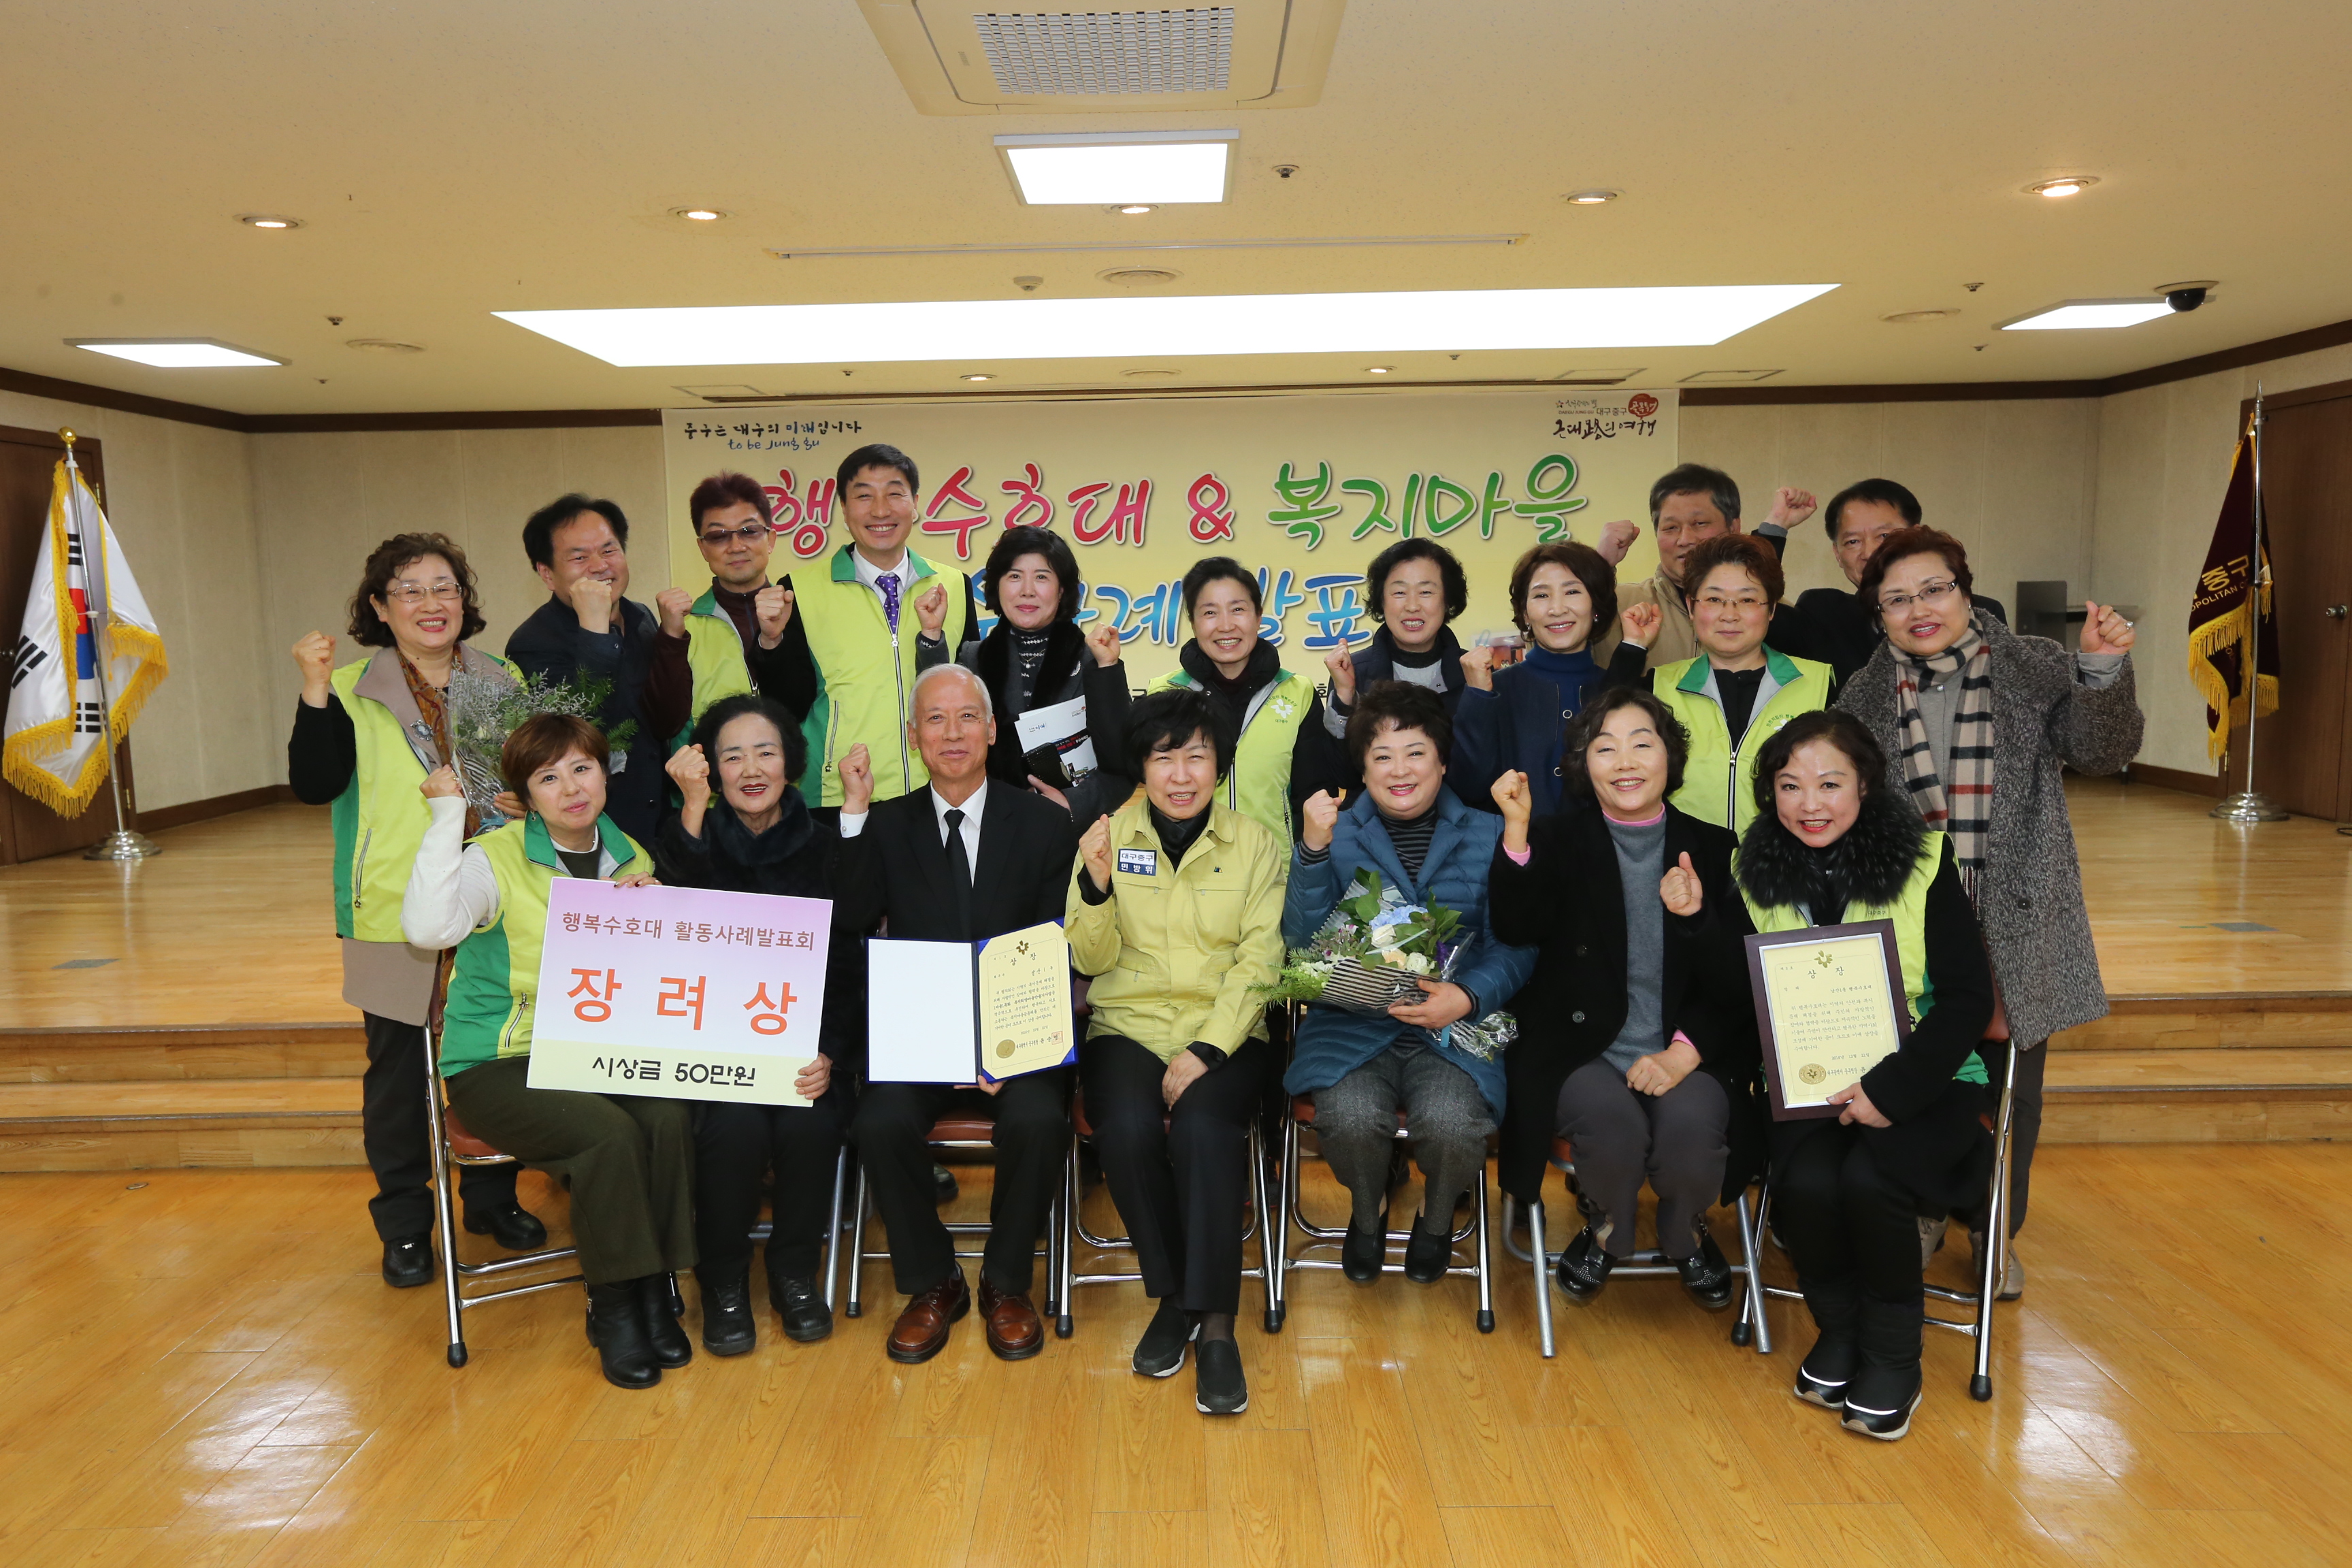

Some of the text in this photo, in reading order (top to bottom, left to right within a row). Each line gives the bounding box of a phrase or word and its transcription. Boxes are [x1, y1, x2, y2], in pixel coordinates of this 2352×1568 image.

[684, 421, 862, 440] 중구는 대구의 미래입니다
[728, 438, 742, 450] to
[747, 438, 762, 449] be
[762, 453, 1586, 558] 행수호대 & 복지마을
[2201, 554, 2249, 591] 중구
[1122, 853, 1153, 862] 대구중구
[562, 912, 815, 951] 행복수호대 활동사례발표회
[1010, 952, 1036, 966] 상 장
[1808, 966, 1844, 979] 상 장
[592, 1056, 756, 1088] 시상금 50만원
